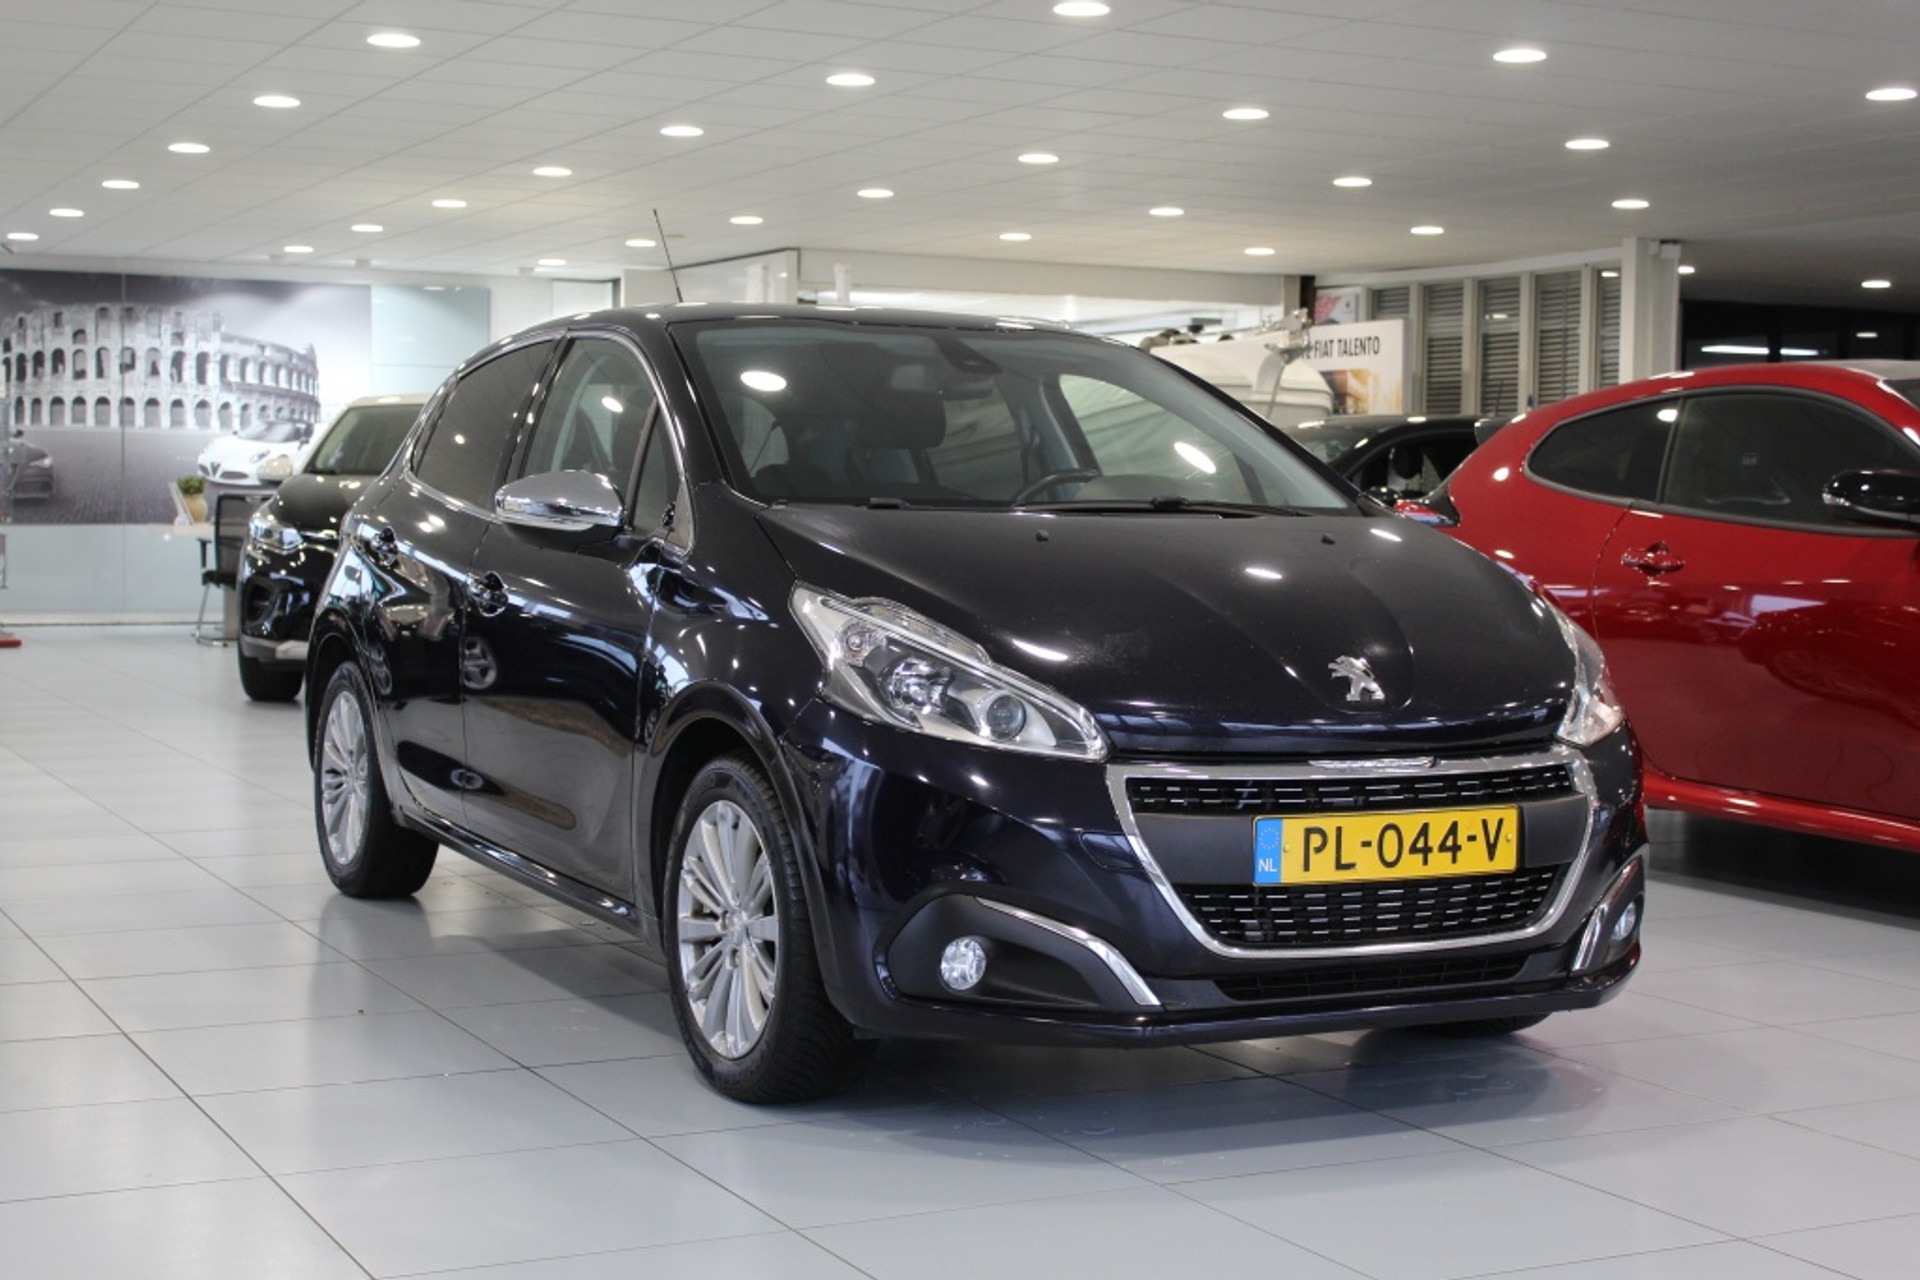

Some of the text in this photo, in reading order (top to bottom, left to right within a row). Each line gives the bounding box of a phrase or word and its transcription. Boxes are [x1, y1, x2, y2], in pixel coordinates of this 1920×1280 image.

[1315, 339, 1334, 359] FIAT
[1337, 336, 1380, 357] TALENTO
[1303, 817, 1504, 873] PL-044-V
[1258, 857, 1278, 872] NL
